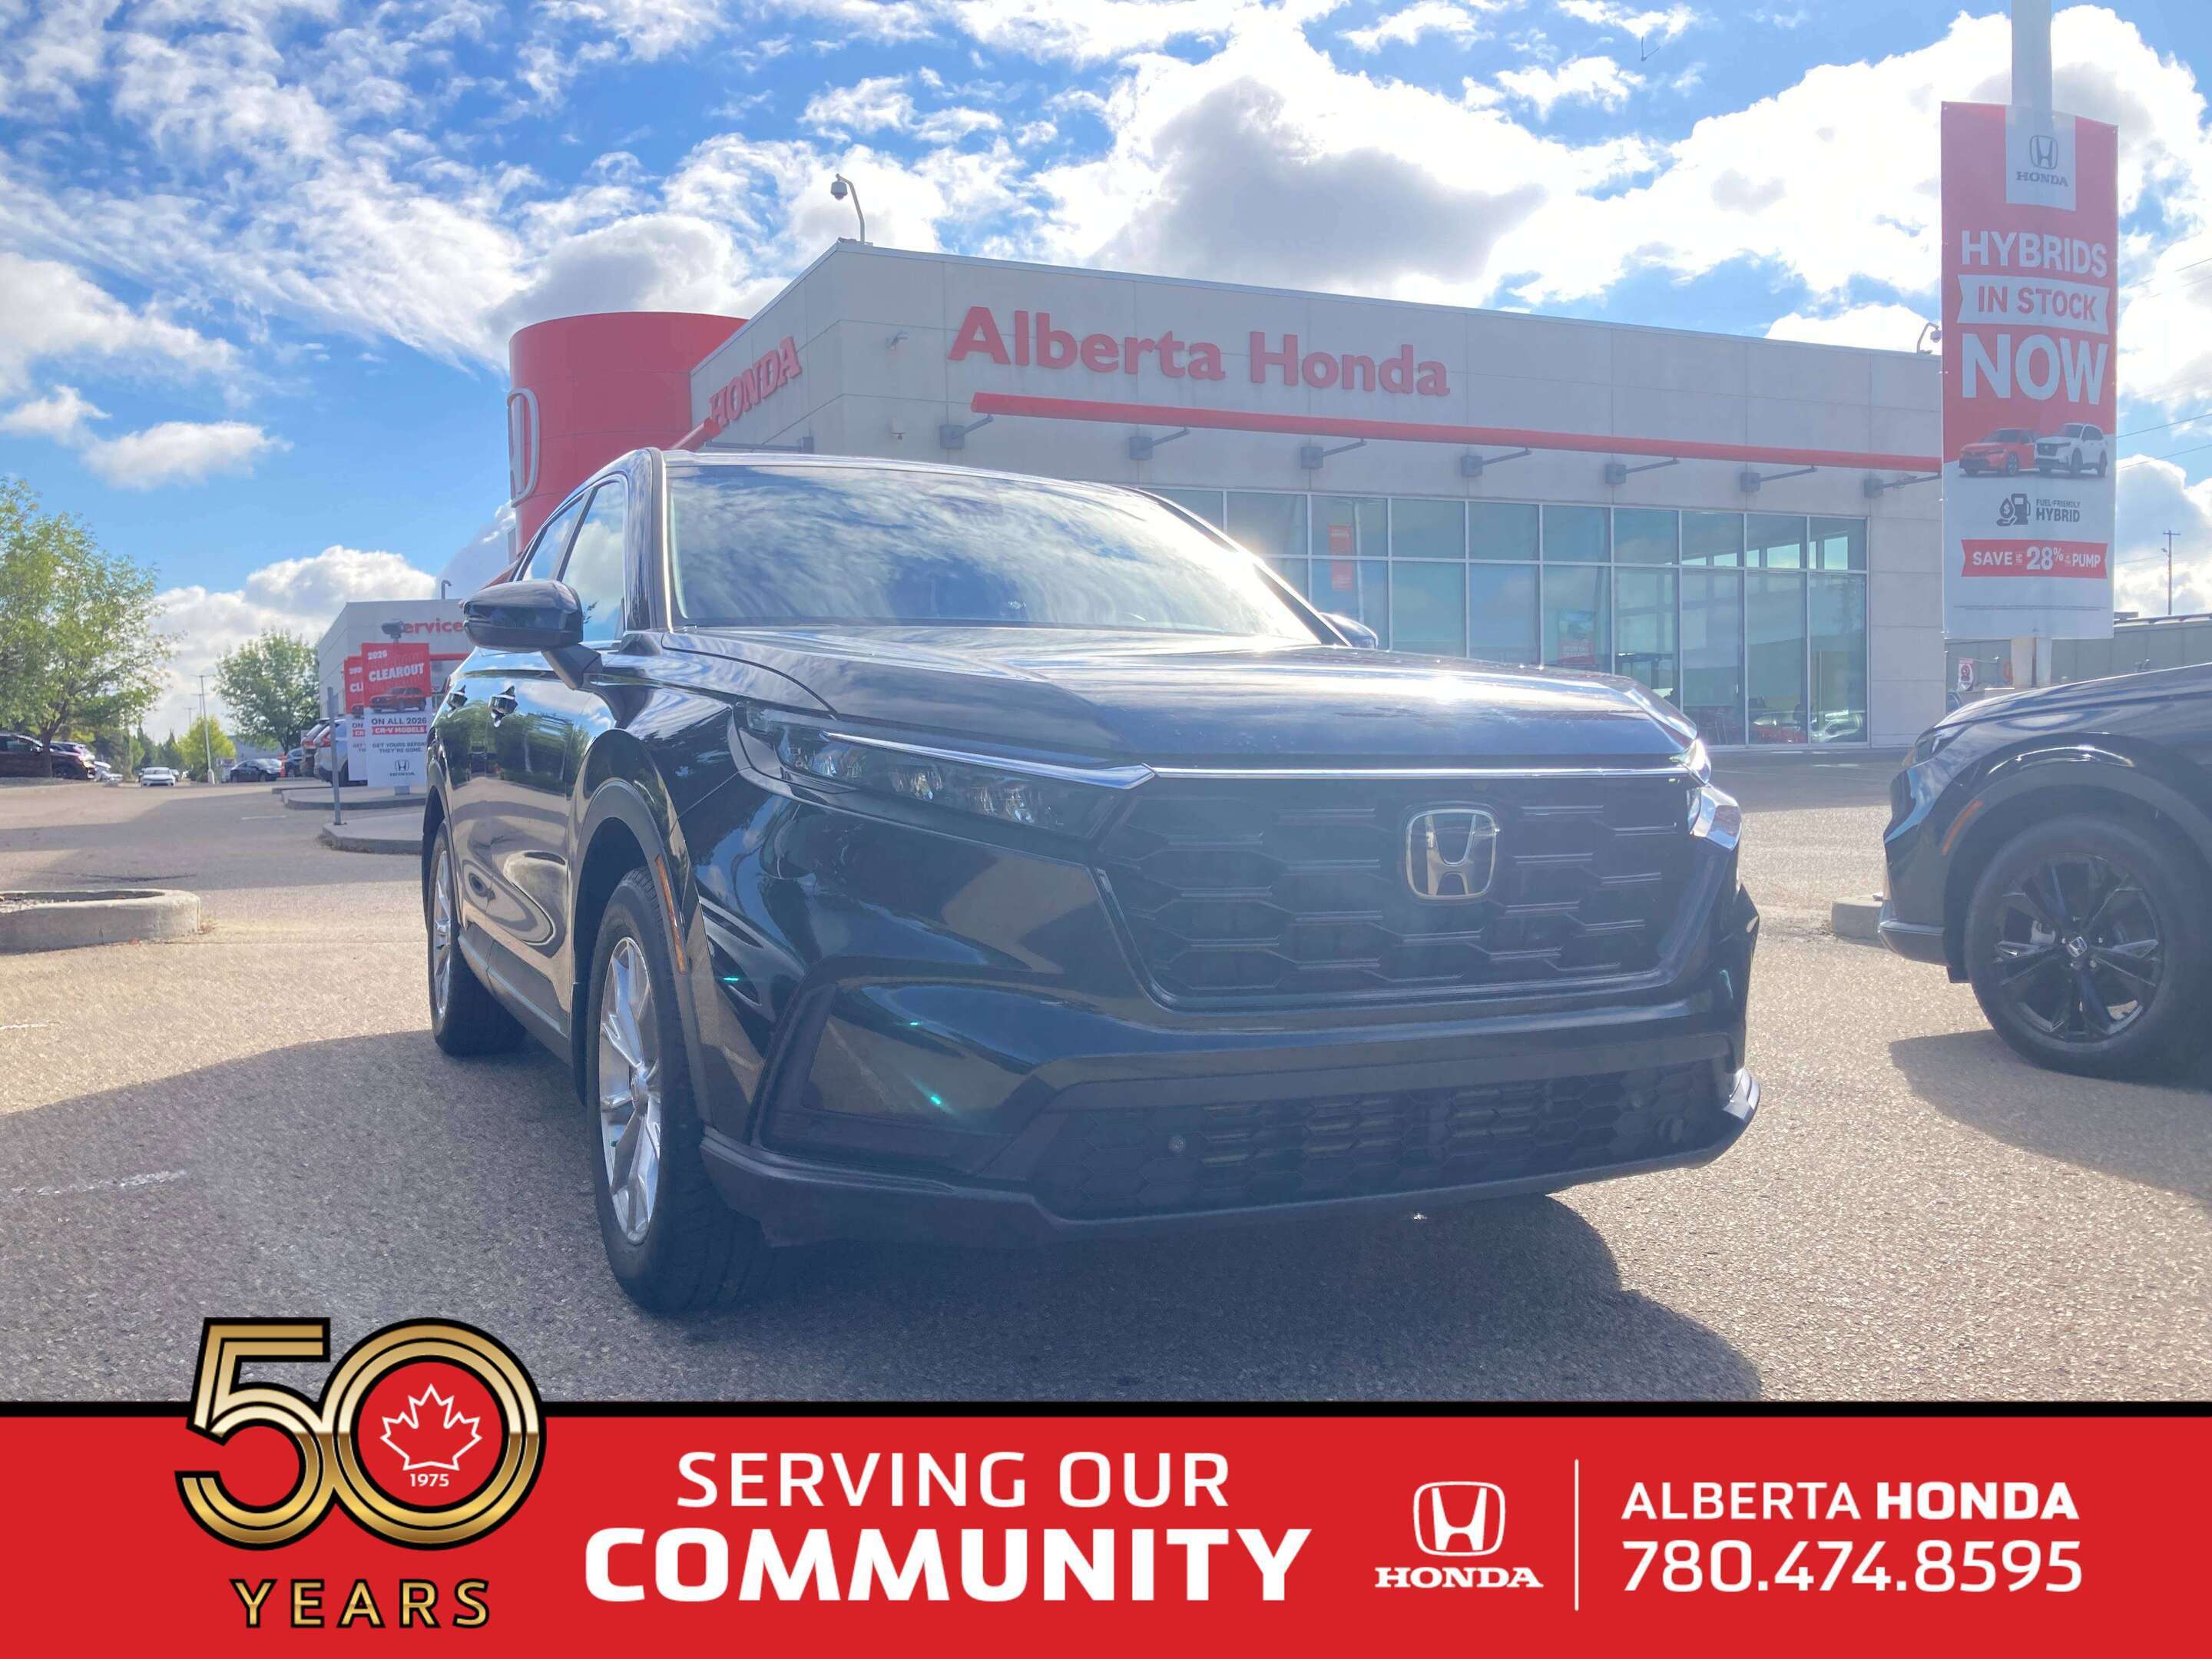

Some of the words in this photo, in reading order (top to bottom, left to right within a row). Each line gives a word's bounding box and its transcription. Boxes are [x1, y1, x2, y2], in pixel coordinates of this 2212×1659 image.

[2015, 171, 2069, 187] HONDA
[1962, 230, 2108, 279] HYBRIDS
[1978, 286, 2008, 313] IN
[2017, 286, 2098, 322] STOCK
[948, 306, 1226, 381] Alberta
[1250, 330, 1451, 396] Honda
[708, 336, 803, 429] HONDA
[1962, 333, 2109, 406] NOW
[2036, 507, 2080, 523] HYBRID
[1972, 551, 2013, 566] SAVE
[2072, 553, 2101, 568] PUMP
[399, 618, 464, 634] ervice
[369, 663, 425, 682] CLEAROUT
